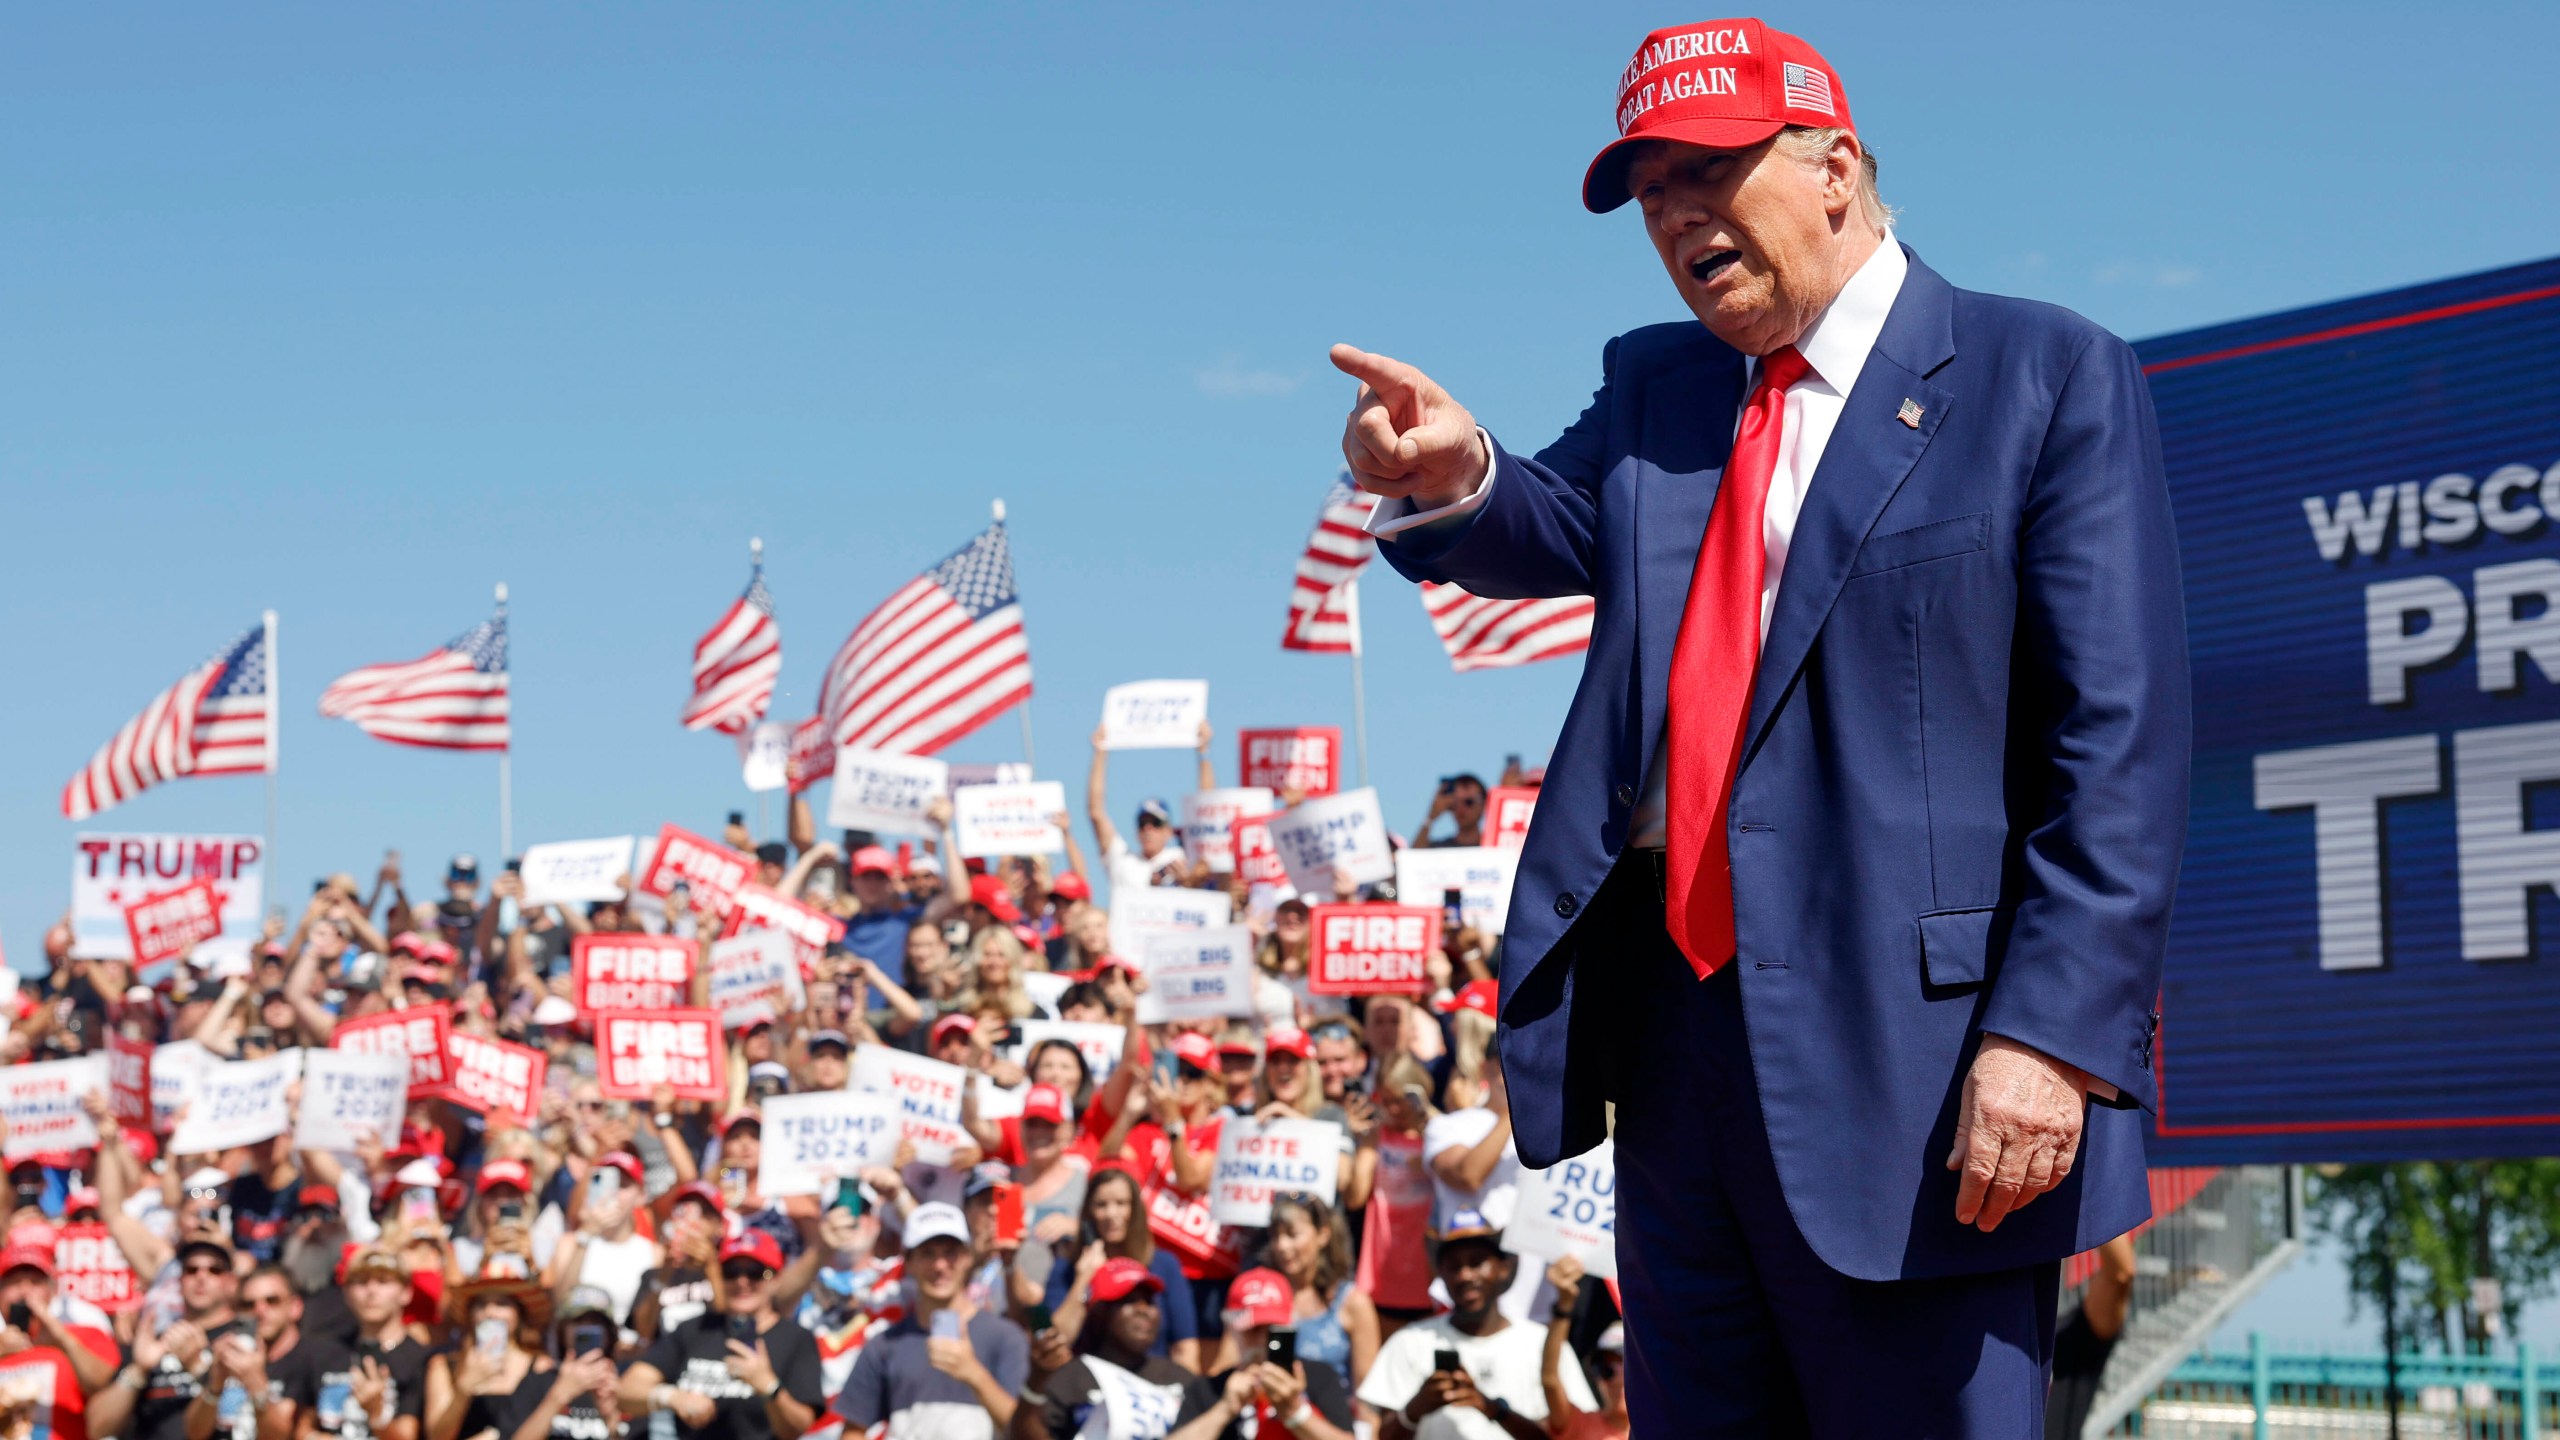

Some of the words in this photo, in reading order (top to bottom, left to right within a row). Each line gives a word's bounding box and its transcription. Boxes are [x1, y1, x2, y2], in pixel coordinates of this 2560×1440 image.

[1641, 28, 1751, 77] AMERICA
[1658, 66, 1736, 106] AGAIN
[1249, 737, 1329, 766] FIRE
[851, 765, 933, 789] TRUMP
[1249, 766, 1329, 791] BIDEN
[861, 788, 920, 810] 2024
[1280, 811, 1366, 853] TRUMP
[78, 840, 260, 880] TRUMP
[663, 838, 746, 894] FIRE
[1325, 916, 1425, 951] FIRE
[587, 946, 688, 982] FIRE
[1325, 952, 1423, 981] BIDEN
[586, 981, 686, 1010] BIDEN
[338, 1016, 438, 1056] FIRE
[610, 1019, 709, 1058] FIRE
[891, 1068, 955, 1100] VOTE
[781, 1114, 886, 1137] TRUMP
[795, 1139, 869, 1161] 2024
[1235, 1136, 1300, 1157] VOTE
